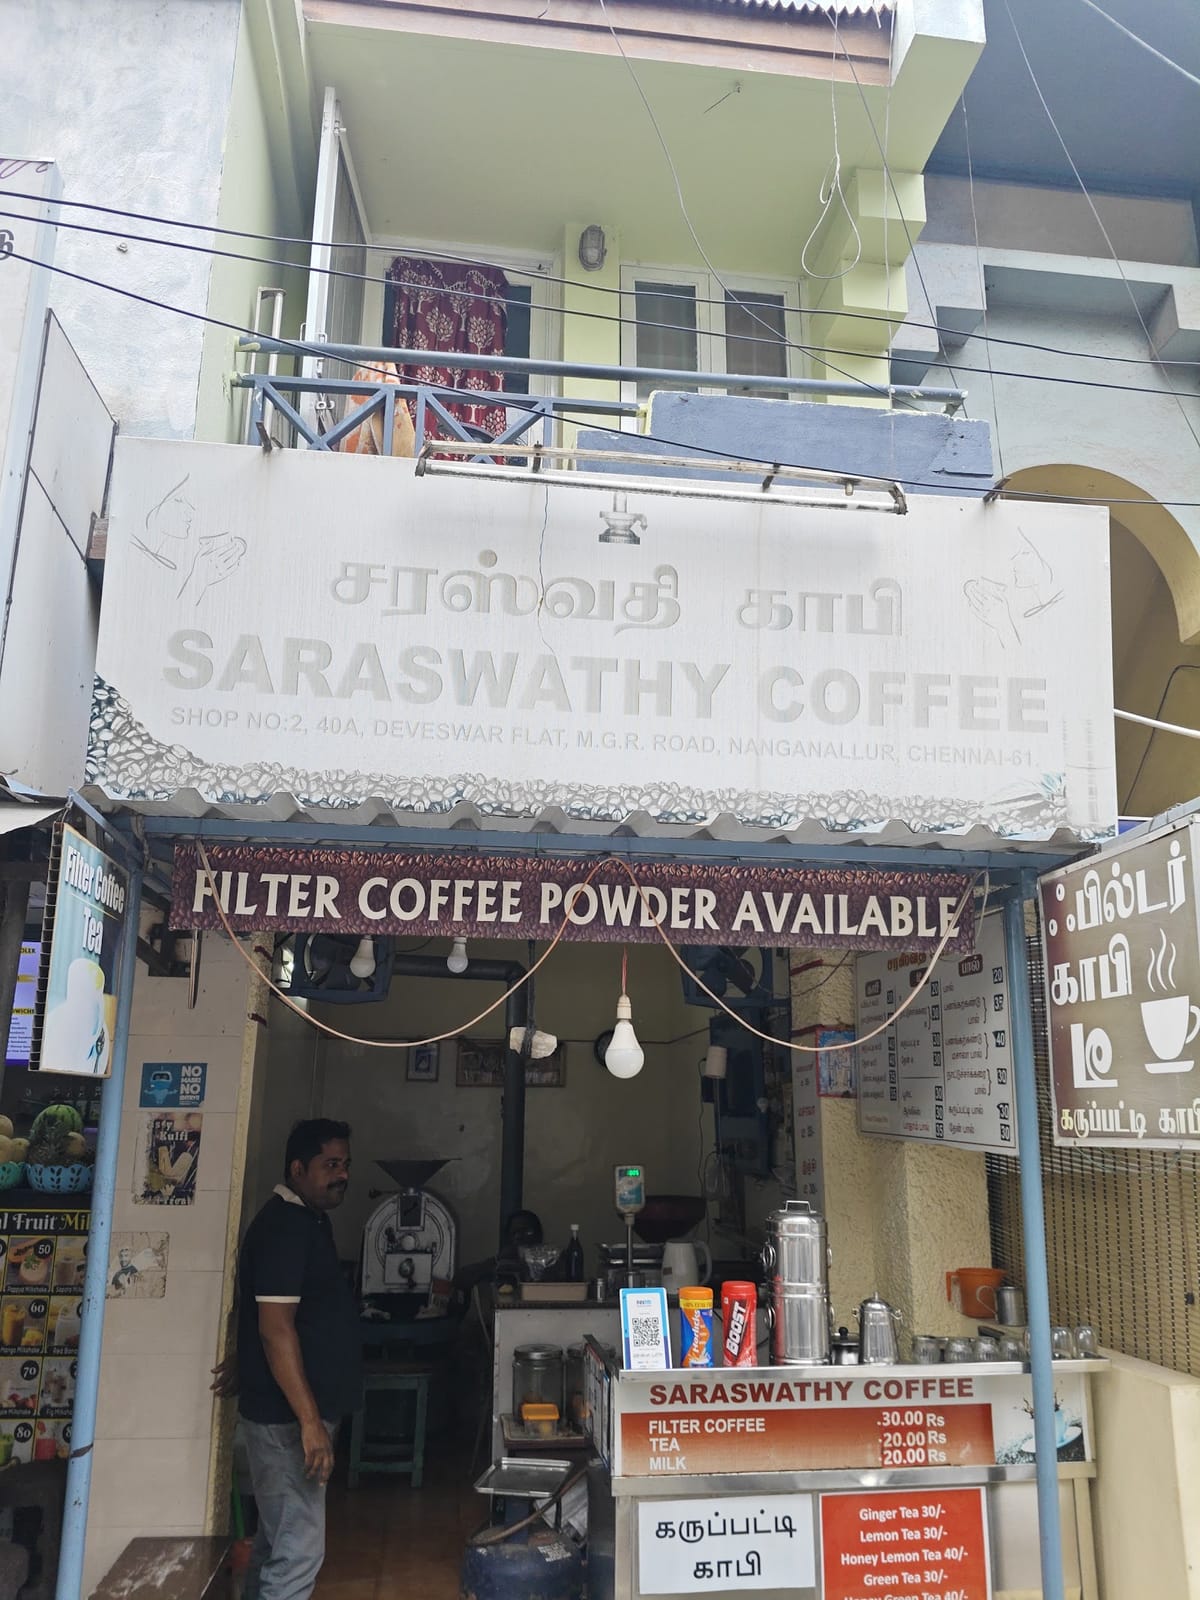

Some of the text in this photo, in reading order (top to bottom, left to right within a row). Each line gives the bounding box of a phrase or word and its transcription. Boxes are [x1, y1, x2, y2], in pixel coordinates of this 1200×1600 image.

[330, 549, 903, 637] சரஸ்வதி காபி
[162, 629, 1049, 733] SARASWATHY COFFEE
[171, 707, 239, 729] SHOP
[248, 712, 308, 735] NO:2,
[316, 715, 365, 738] 40A,
[374, 718, 504, 744] DEVESWAR
[512, 726, 569, 750] FLAT,
[577, 730, 645, 751] M.G.R.
[654, 734, 722, 756] ROAD,
[728, 737, 901, 763] NANGANALLUR,
[65, 845, 126, 914] Filter Coffee
[1049, 840, 1187, 936] ஃபில்டர்
[192, 869, 961, 938] FILTER COFFEE POWDER AVAILABLE
[82, 906, 104, 955] Tea
[993, 968, 1003, 982] 20
[1051, 933, 1133, 1006] காபி
[995, 1032, 1005, 1046] 40
[181, 1065, 203, 1077] NO
[180, 1083, 201, 1095] NO
[999, 1104, 1009, 1119] 30
[1060, 1100, 1148, 1139] கருப்பட்டி
[159, 1130, 189, 1141] Kulfi
[1001, 1125, 1010, 1140] 30
[12, 1213, 58, 1231] Fruit
[38, 1244, 51, 1255] 50
[30, 1303, 45, 1313] 60
[691, 1309, 701, 1353] Horlicks
[725, 1301, 747, 1357] BOOST
[23, 1366, 37, 1379] 70
[650, 1377, 974, 1406] SARASWATHY COFFEE
[649, 1418, 766, 1435] FILTER COFFEE
[926, 1413, 945, 1427] Rs
[16, 1426, 31, 1438] 80
[927, 1430, 947, 1444] Rs
[650, 1438, 681, 1452] TEA
[650, 1455, 687, 1471] MILK
[927, 1449, 947, 1462] Rs
[859, 1504, 946, 1523] Ginger Tea 30/-
[655, 1509, 797, 1543] கருப்பட்டி
[860, 1525, 948, 1543] Lemon Tea 30/-
[693, 1550, 762, 1579] காபி
[841, 1546, 969, 1567] Honey Lemon Tea 40/-
[863, 1569, 949, 1586] Green Tea 30/-
